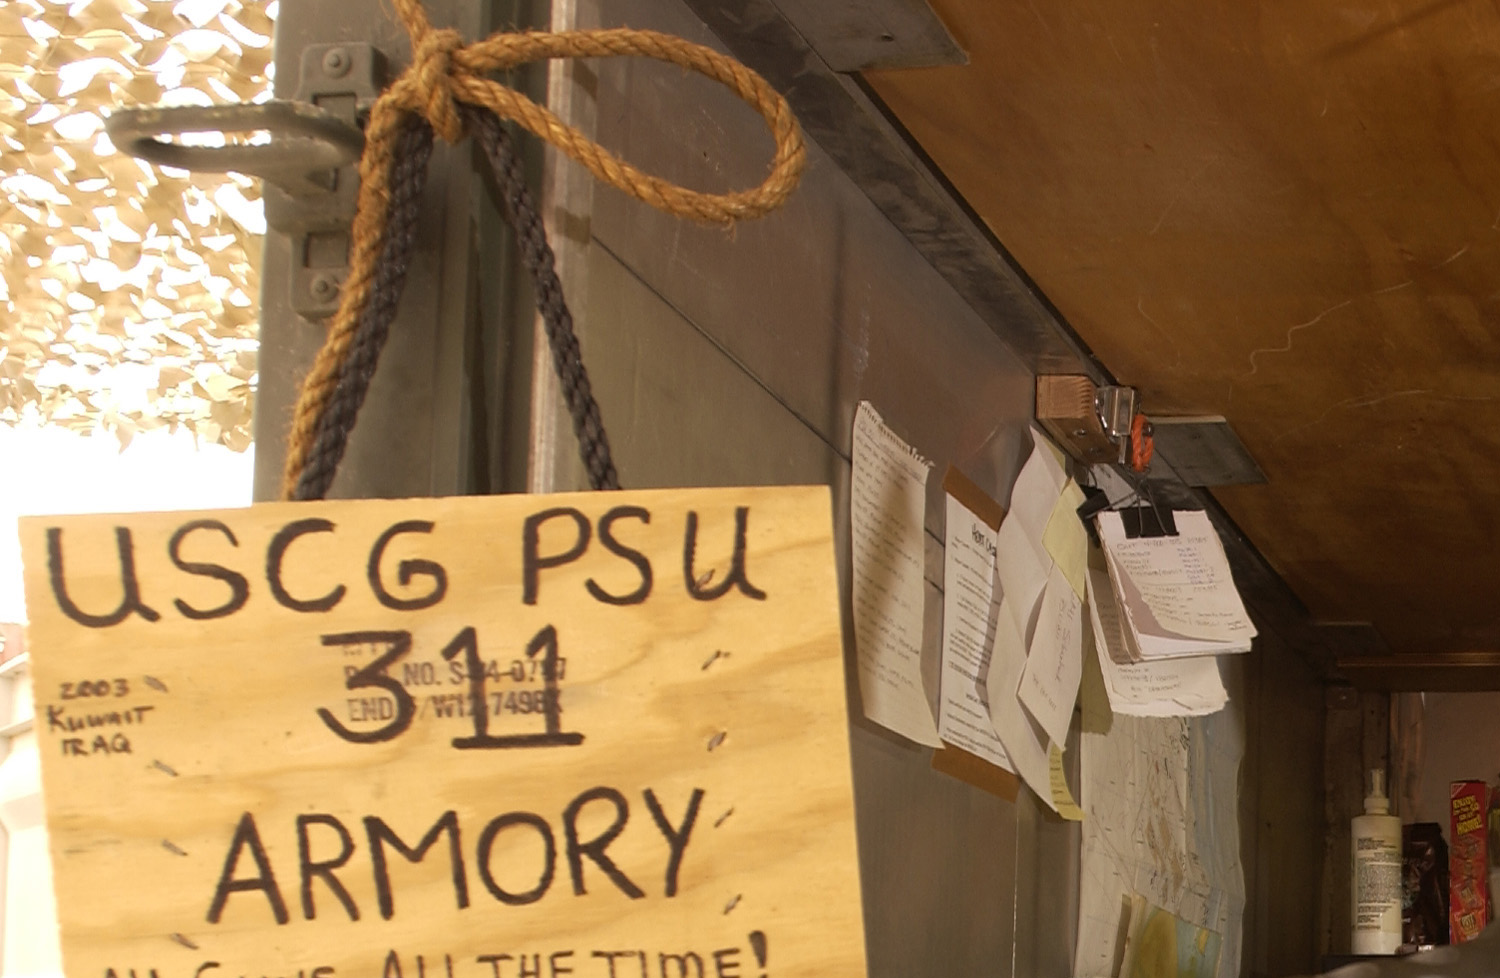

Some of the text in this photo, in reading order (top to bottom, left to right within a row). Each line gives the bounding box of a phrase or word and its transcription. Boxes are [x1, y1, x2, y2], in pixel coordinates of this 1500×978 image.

[46, 505, 767, 628] USCG PSU
[59, 677, 131, 700] 2003
[61, 732, 133, 756] IRAQ
[316, 623, 585, 750] 311
[206, 785, 705, 925] ARMORY
